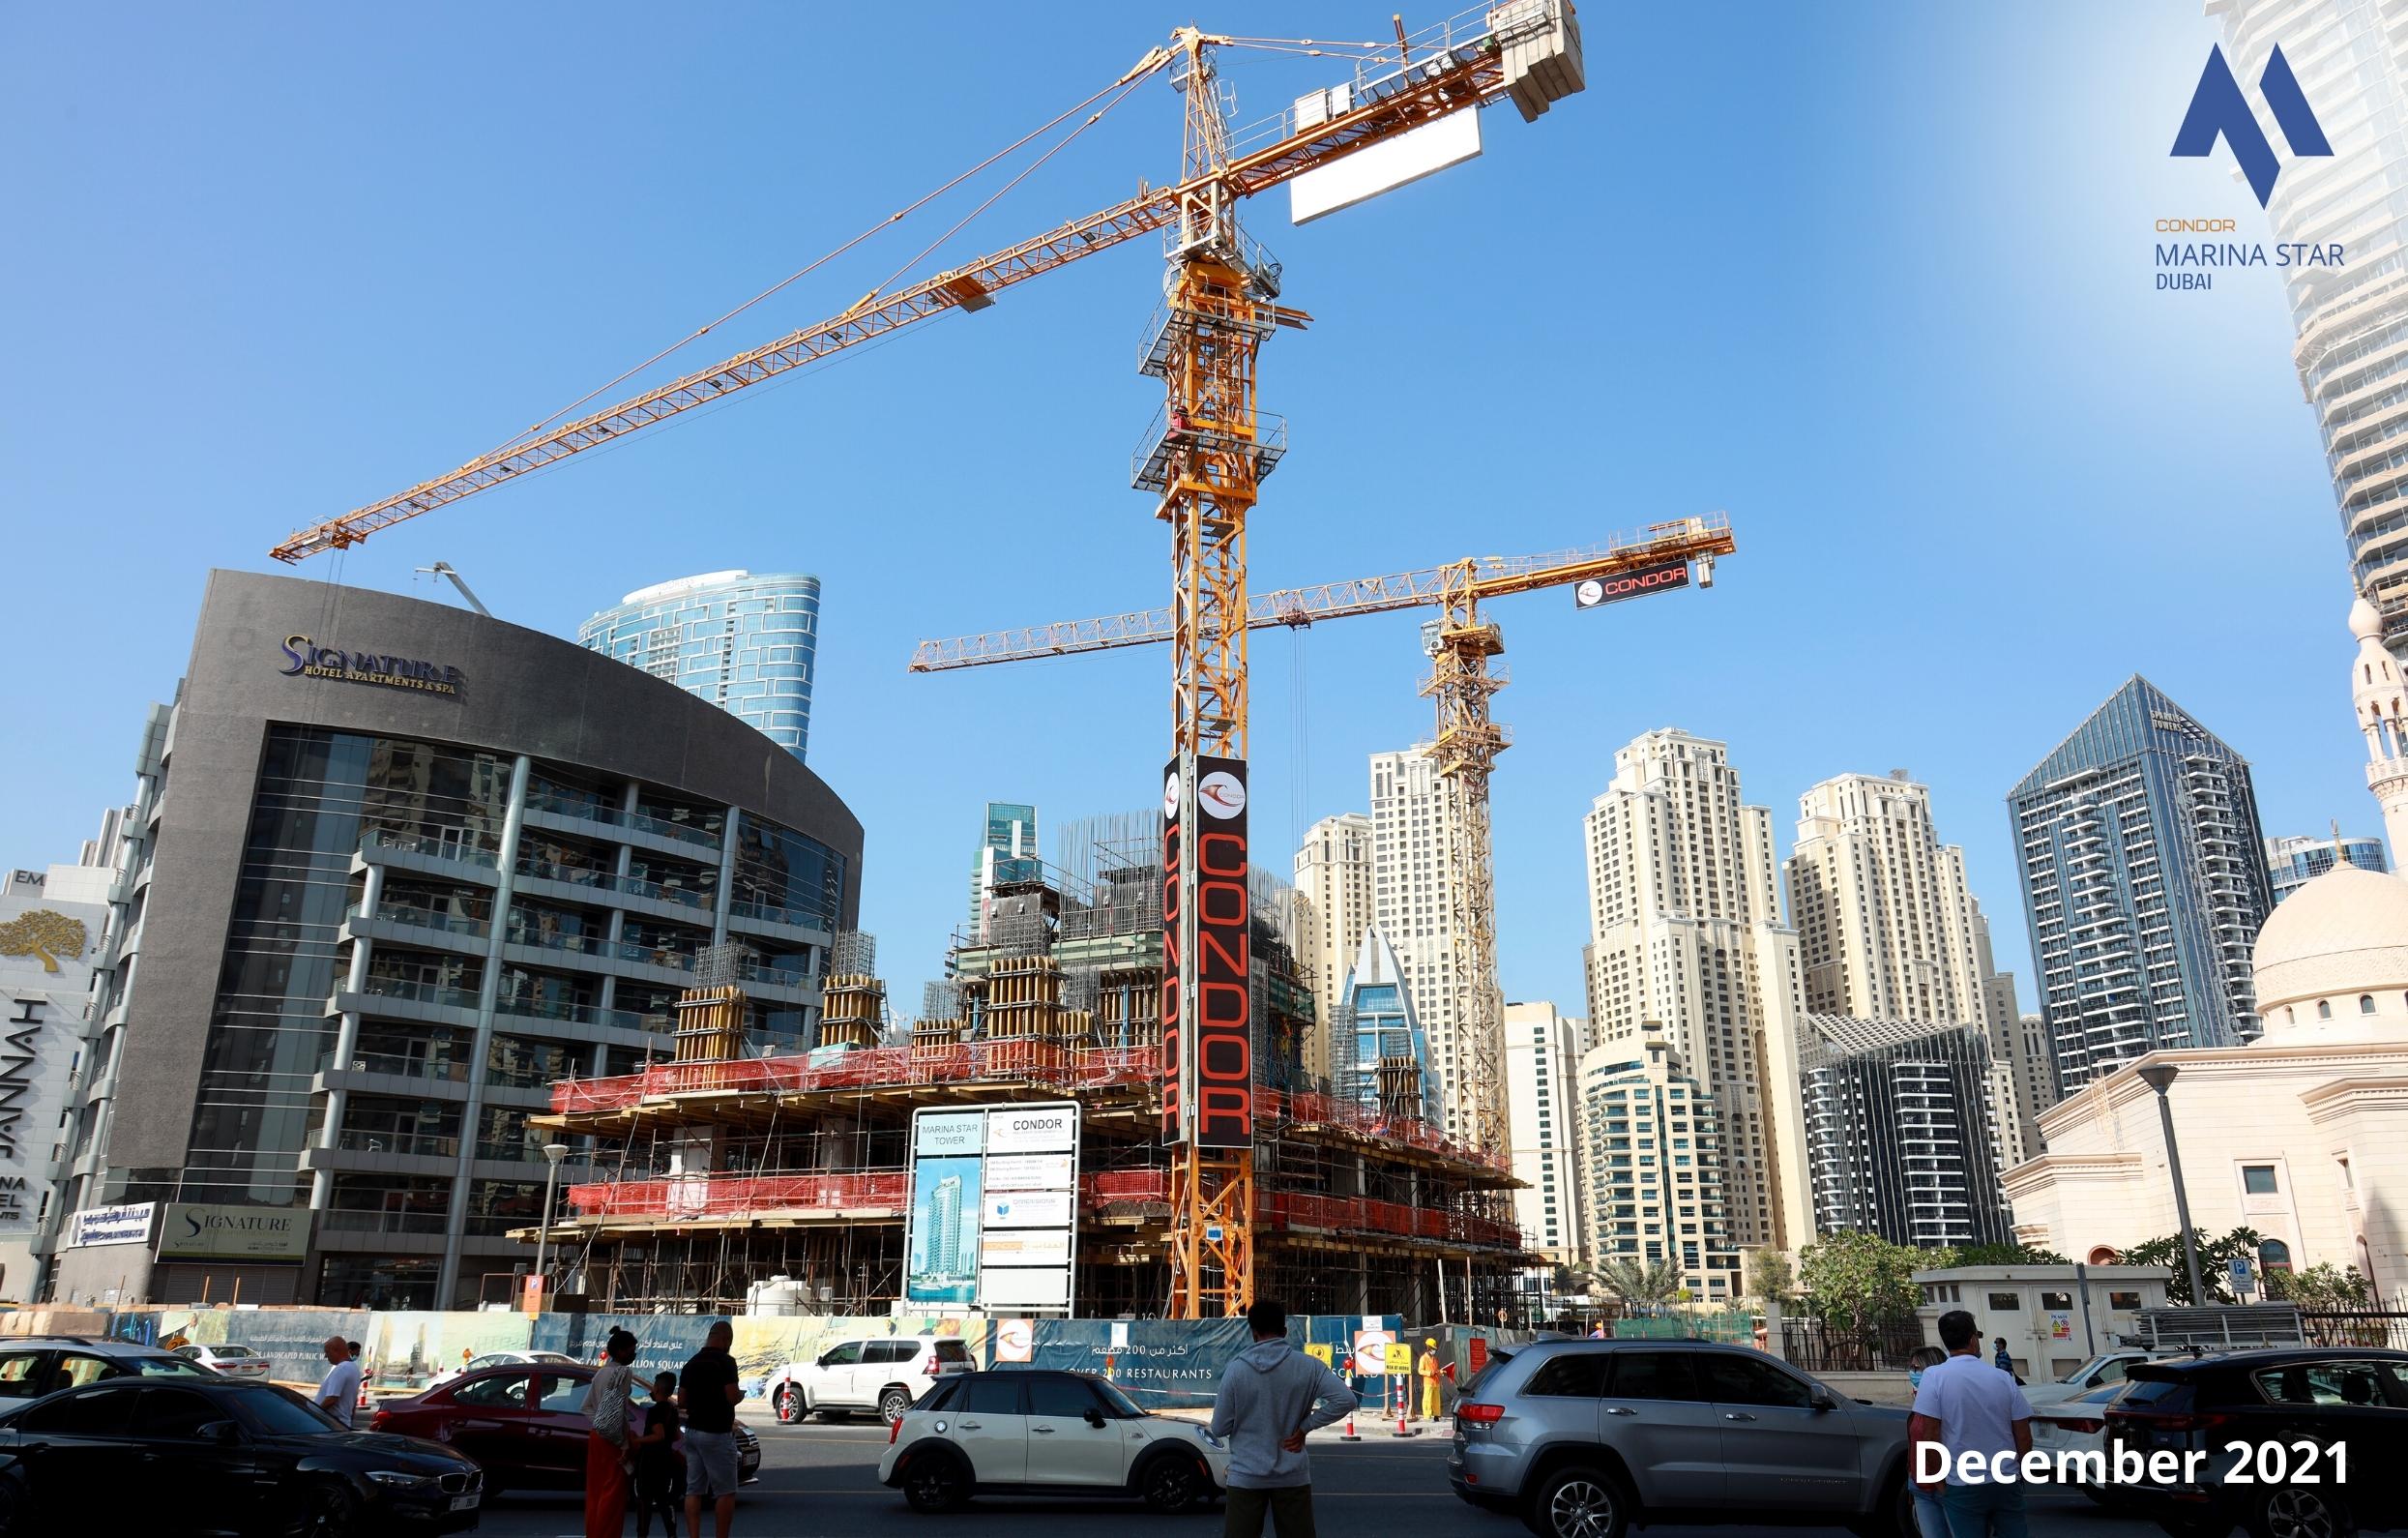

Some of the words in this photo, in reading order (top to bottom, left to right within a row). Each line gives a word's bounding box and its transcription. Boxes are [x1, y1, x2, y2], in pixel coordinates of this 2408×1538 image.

[1604, 567, 1687, 596] CONDOR
[305, 665, 343, 679] HOTEL
[344, 670, 424, 690] APARTMENTS
[425, 680, 433, 691] &
[435, 682, 455, 695] SPA
[1162, 823, 1180, 1133] CONDOR
[1198, 832, 1250, 1136] CONDOR
[922, 1125, 955, 1135] MARINA
[956, 1123, 979, 1134] STAR
[1013, 1118, 1063, 1131] CONDOR
[934, 1136, 965, 1145] TOWER
[186, 1207, 292, 1237] SIGNATURE
[1126, 1345, 1146, 1354] 200
[1149, 1347, 1164, 1357] من
[1167, 1345, 1189, 1356] أكثر
[1127, 1368, 1212, 1379] RESTAURANTS
